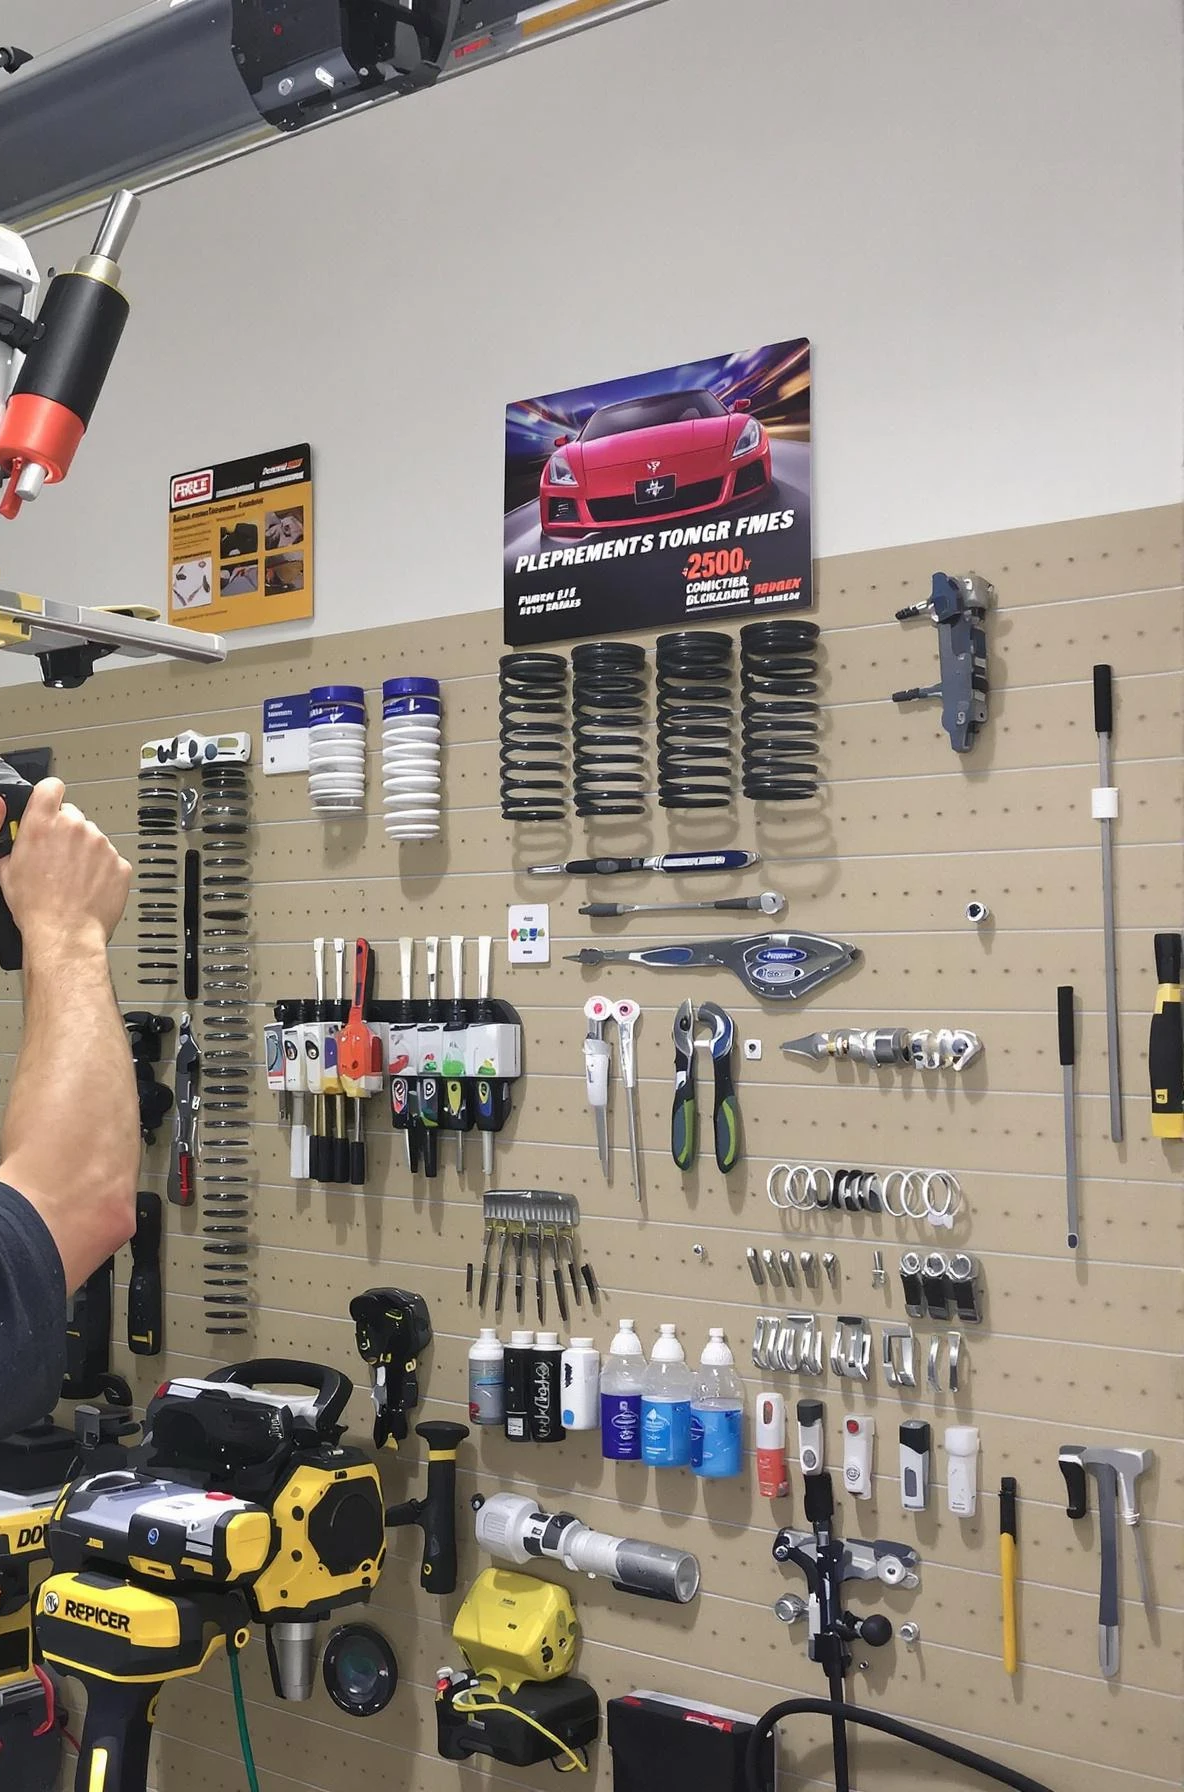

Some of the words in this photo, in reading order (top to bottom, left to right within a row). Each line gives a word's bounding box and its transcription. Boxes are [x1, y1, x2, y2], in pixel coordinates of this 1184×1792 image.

[515, 533, 654, 574] PLEPREMENTS
[659, 520, 731, 550] TONGR
[687, 547, 744, 580] 2500
[65, 1600, 131, 1633] REPICER
